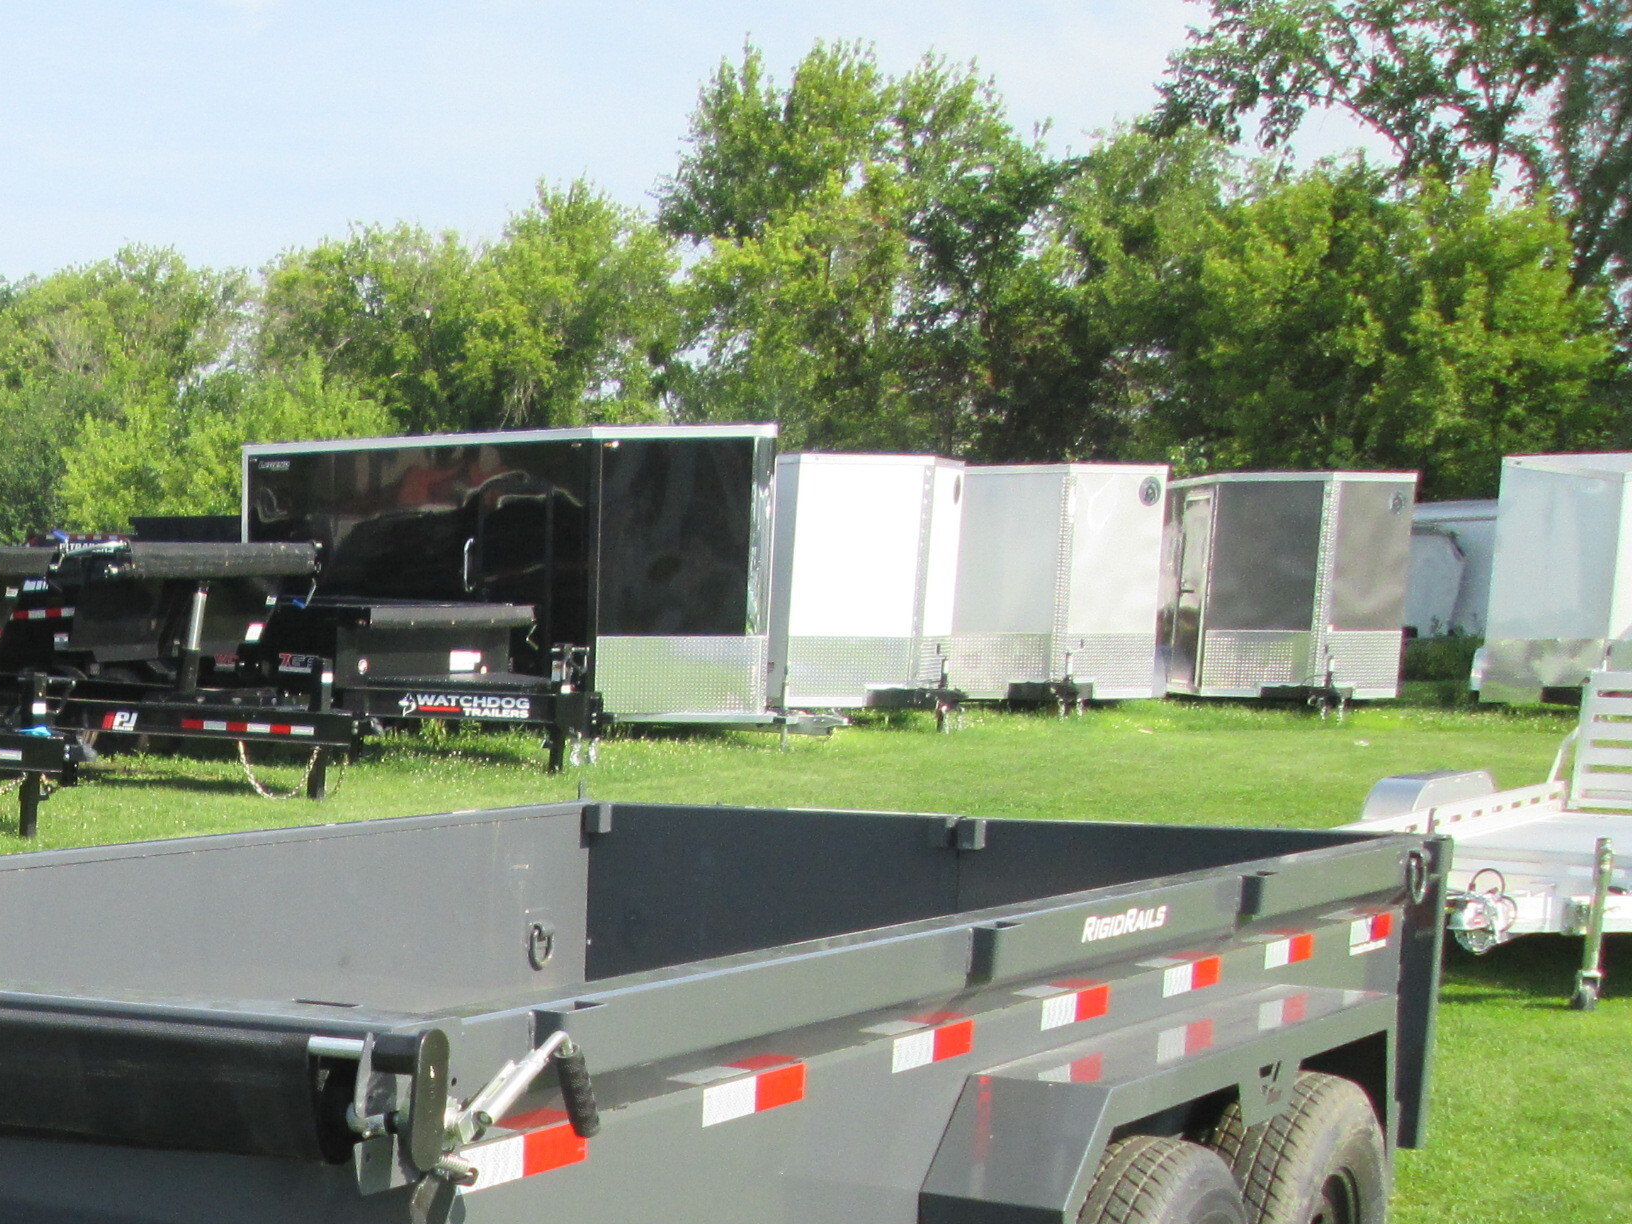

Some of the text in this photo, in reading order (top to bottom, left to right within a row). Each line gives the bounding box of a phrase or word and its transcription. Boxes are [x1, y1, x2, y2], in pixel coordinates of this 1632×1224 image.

[416, 694, 530, 709] WATCHDOG
[114, 711, 138, 727] PJ
[463, 707, 529, 718] TRAILERS
